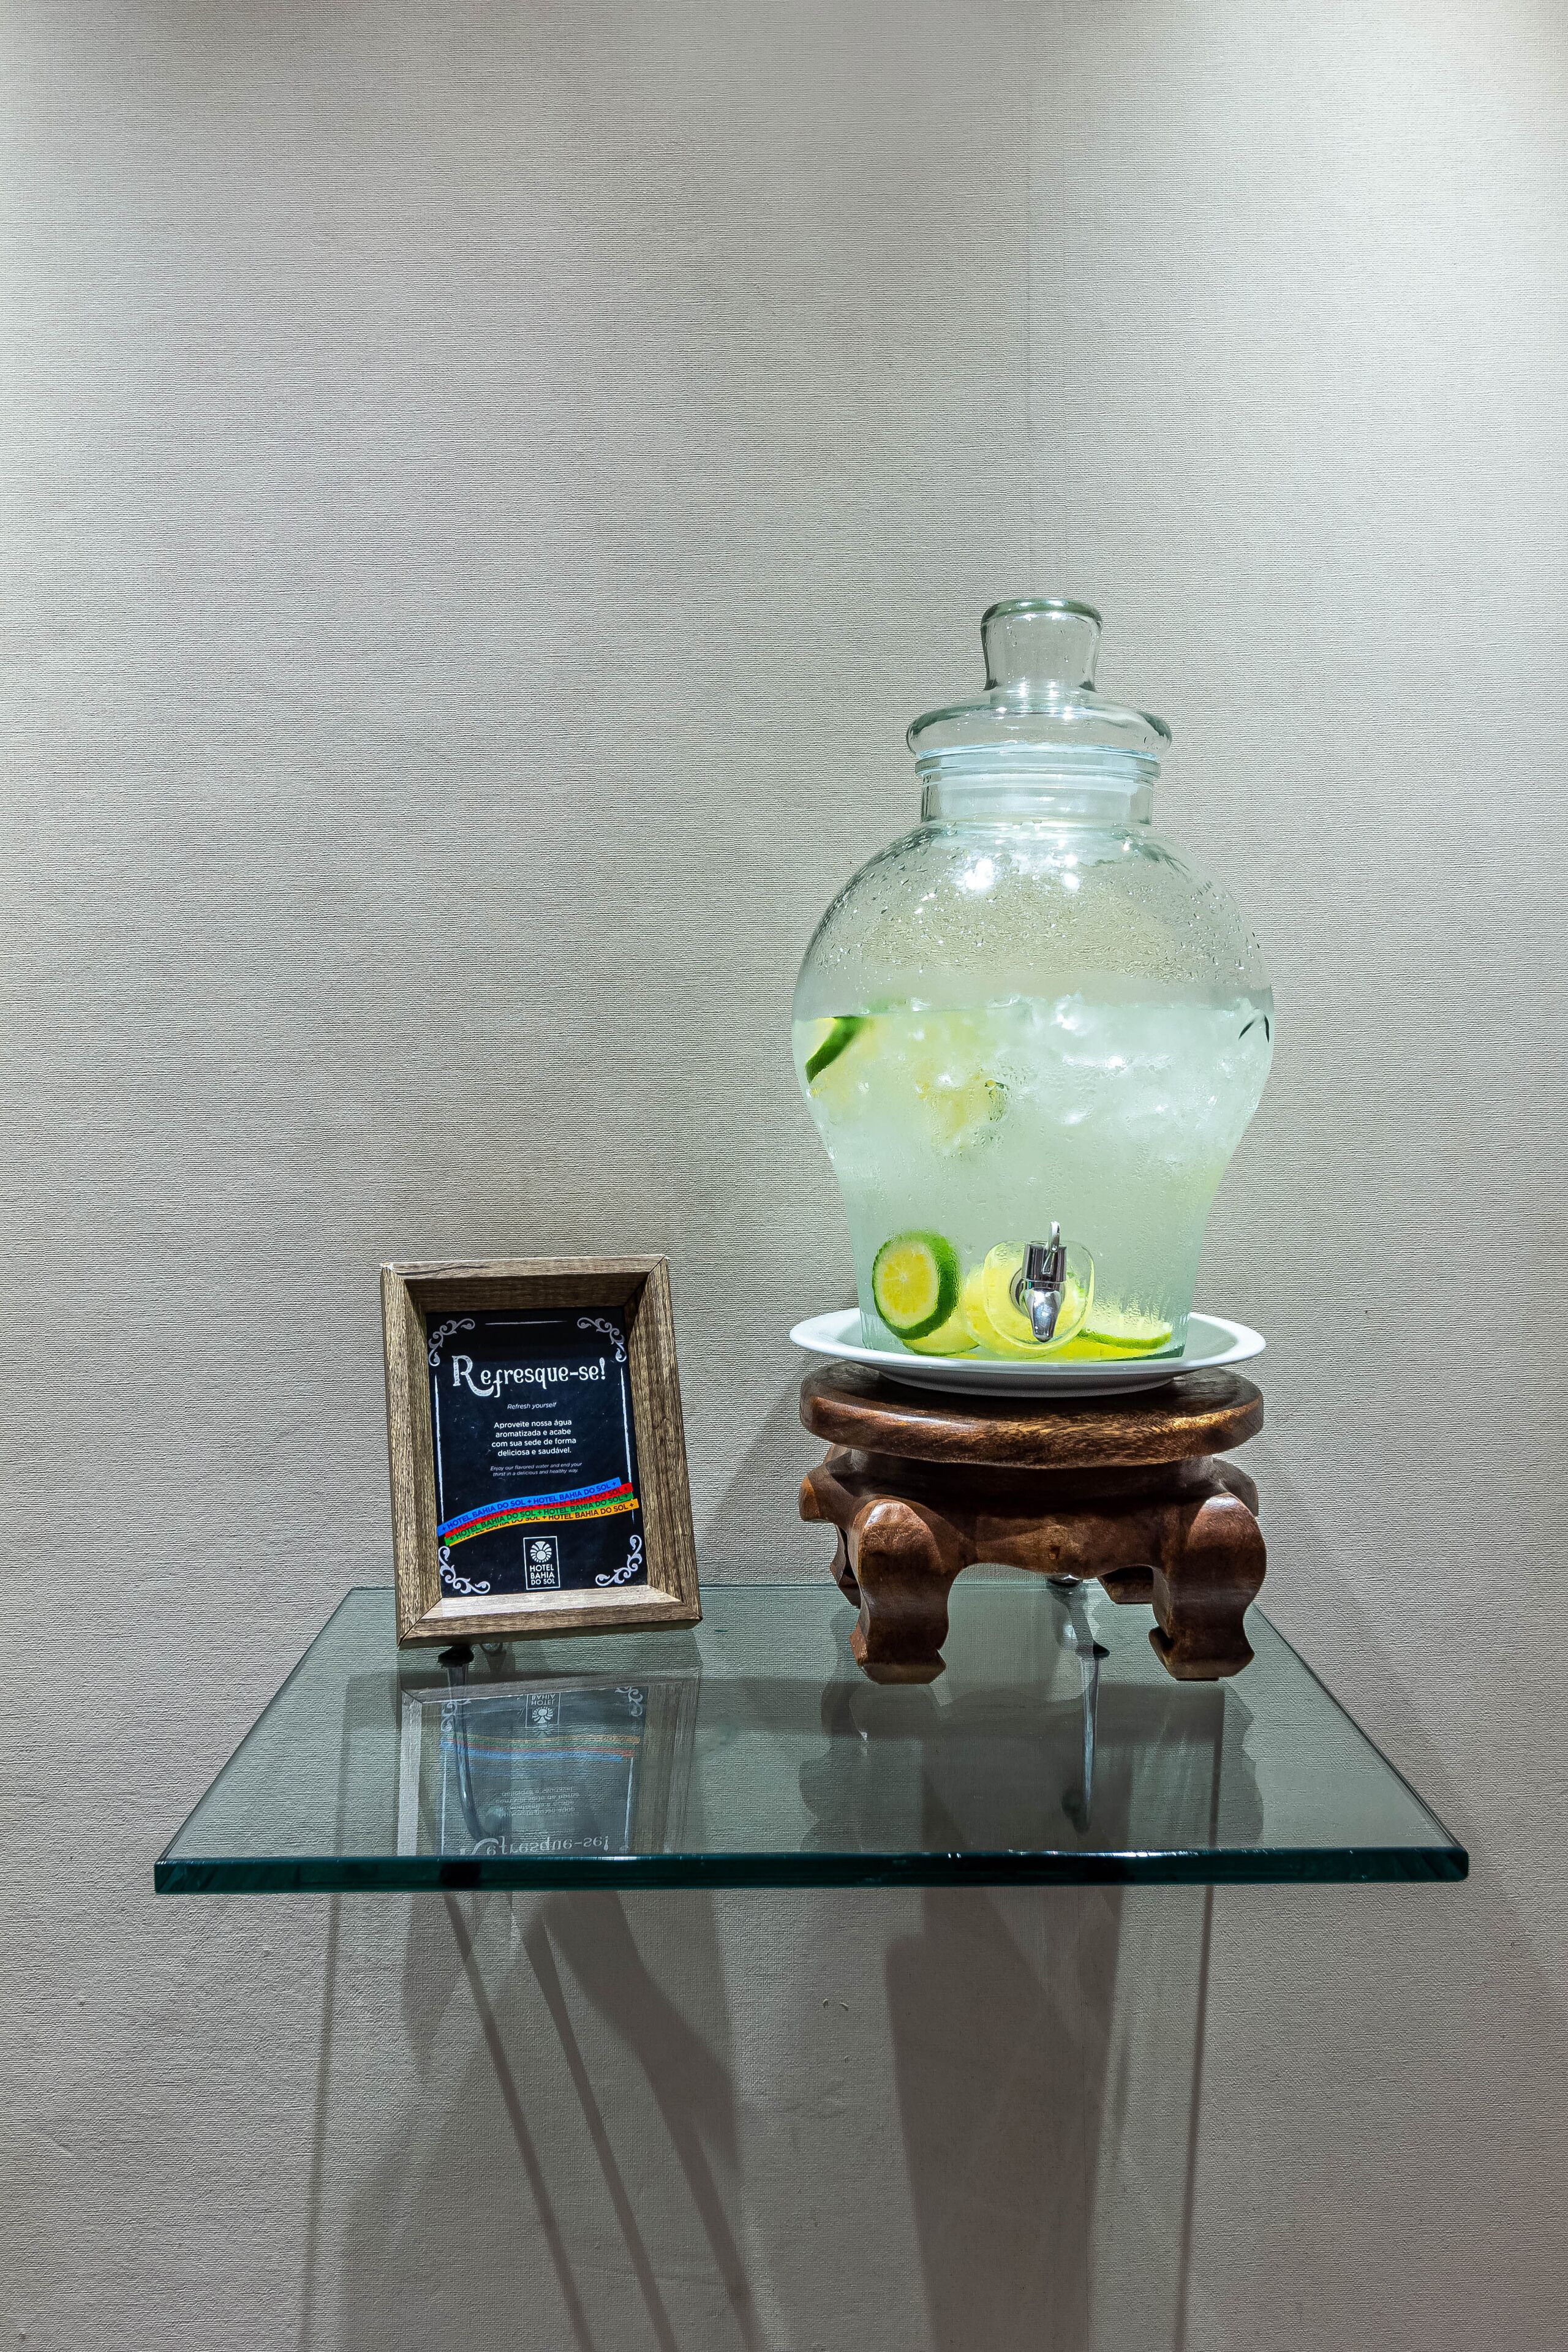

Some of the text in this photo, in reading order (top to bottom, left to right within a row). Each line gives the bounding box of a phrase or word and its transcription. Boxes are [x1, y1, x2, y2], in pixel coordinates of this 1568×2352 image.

[451, 1355, 606, 1398] Refresque-se!
[494, 1420, 529, 1429] Aproveite
[447, 1515, 472, 1529] HOTEL
[472, 1506, 496, 1518] BAHIA
[559, 1490, 582, 1501] BAHIA
[596, 1483, 611, 1491] SOL
[570, 1496, 594, 1505] BAHIA
[608, 1488, 623, 1496] SOL
[455, 1525, 481, 1539] HOTEL
[480, 1516, 505, 1528] BAHIA
[543, 1506, 569, 1515] HOTEL
[570, 1502, 594, 1512] BAHIA
[575, 1509, 598, 1518] BAHIA
